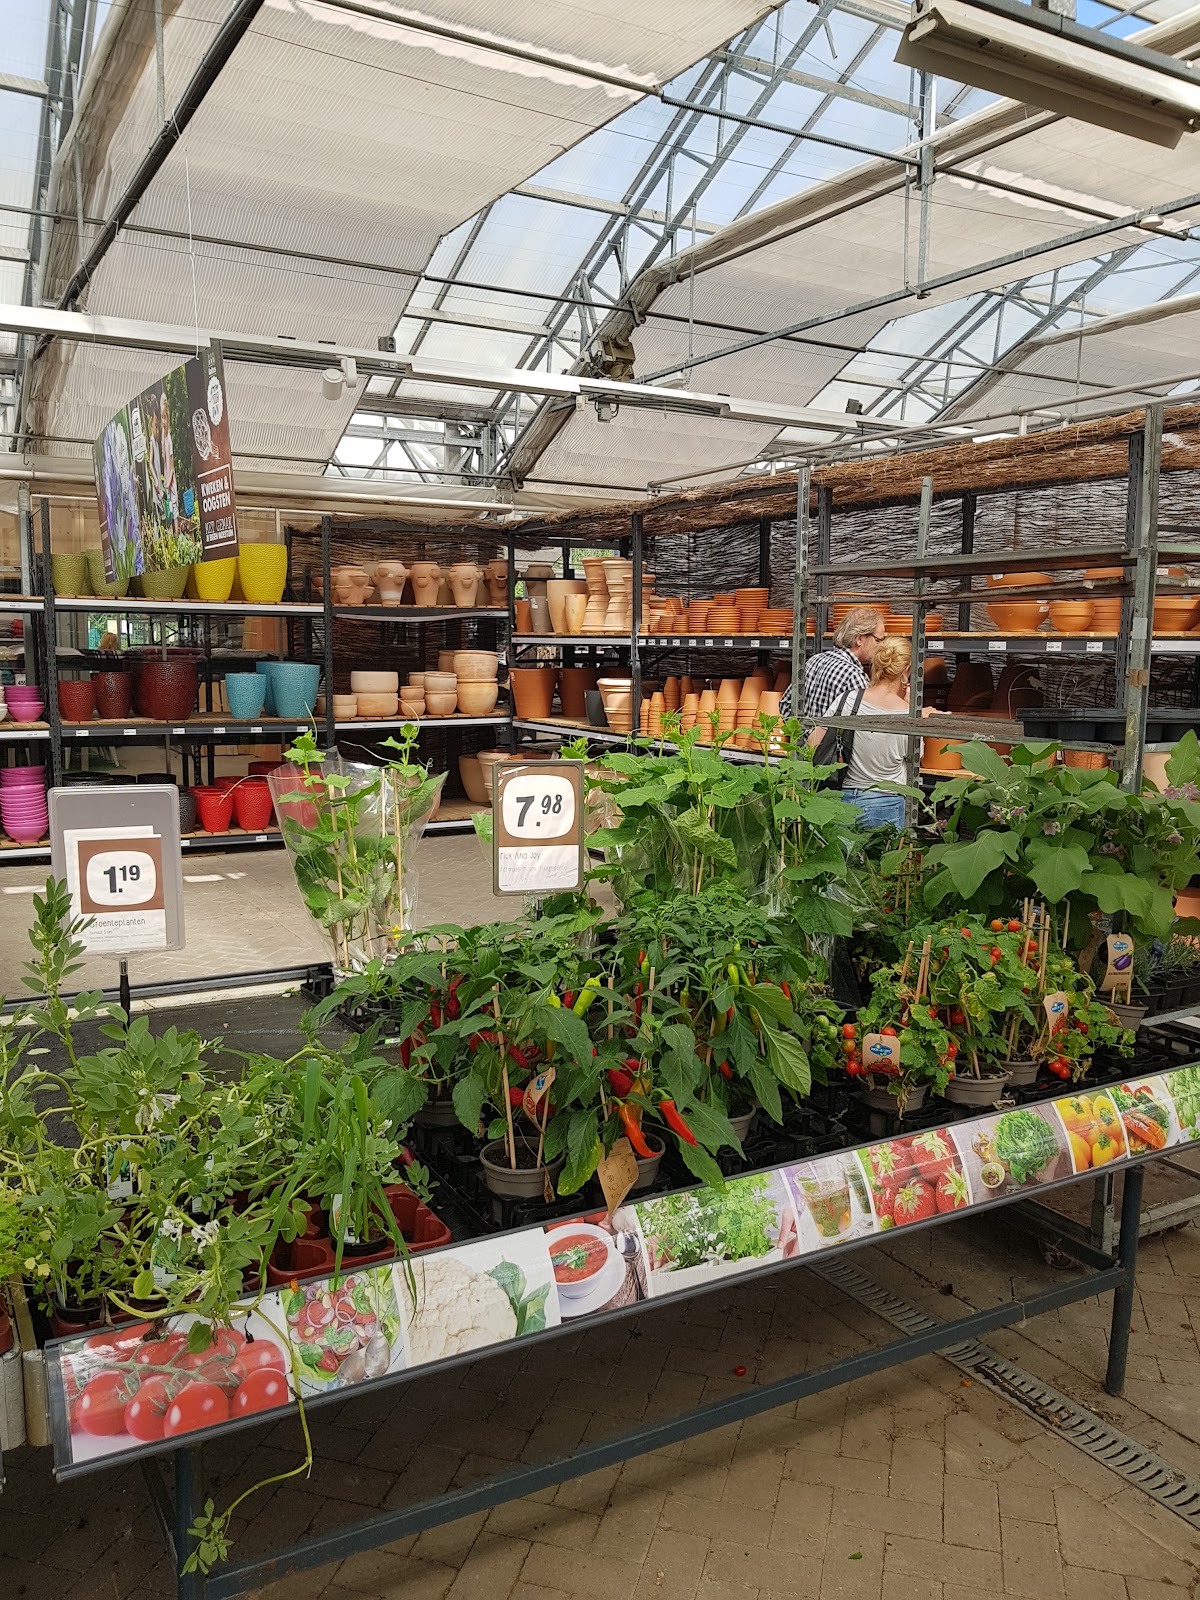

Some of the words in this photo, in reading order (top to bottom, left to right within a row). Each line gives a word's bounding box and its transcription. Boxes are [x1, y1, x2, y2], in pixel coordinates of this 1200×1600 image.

[201, 478, 224, 497] KWEKEN
[224, 476, 229, 489] &
[203, 492, 231, 512] OOGSTEN
[516, 794, 563, 828] 7.98
[514, 852, 528, 860] And
[529, 852, 541, 861] Joy
[103, 864, 141, 894] 1.19
